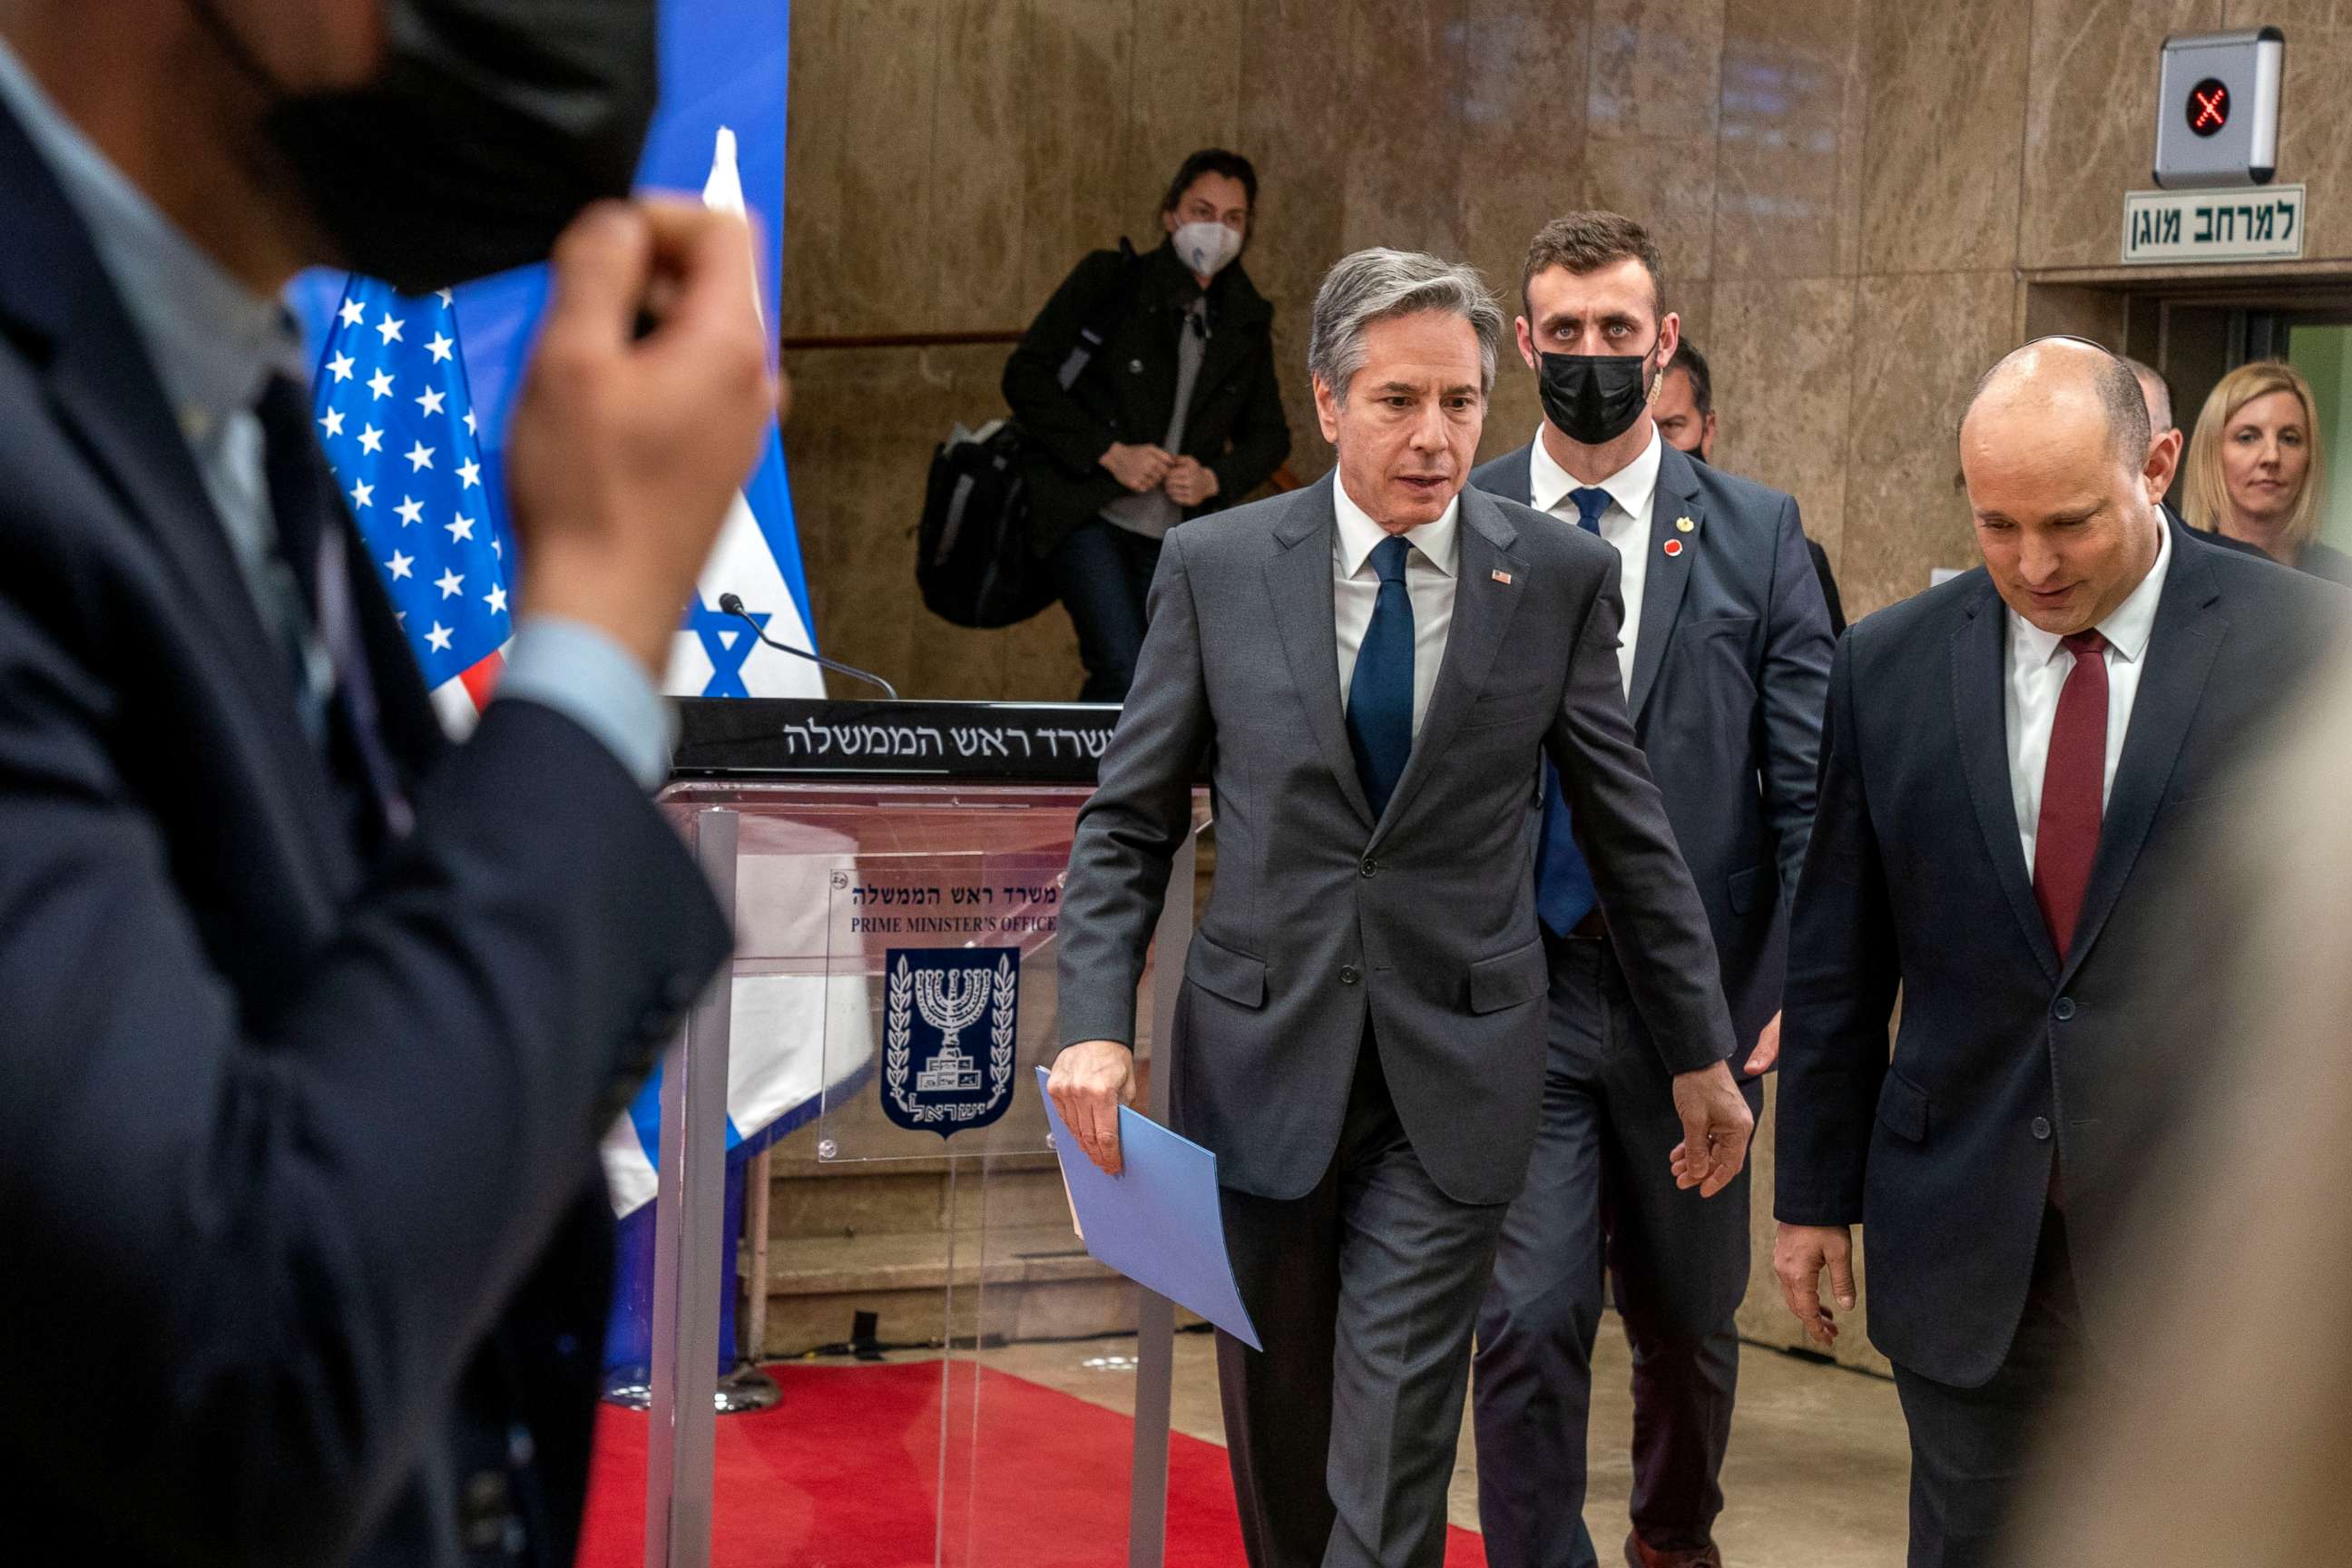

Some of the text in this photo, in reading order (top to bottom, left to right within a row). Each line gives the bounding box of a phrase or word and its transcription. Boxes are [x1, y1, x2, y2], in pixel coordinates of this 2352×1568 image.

[2132, 199, 2295, 251] למרחב מוגן
[783, 716, 1114, 759] שרד ראש הממשלה
[851, 883, 1058, 906] משרד ראש הממשלה
[851, 916, 1058, 933] PRIME MINISTER'S OFFICE
[908, 1092, 986, 1122] ישראל
